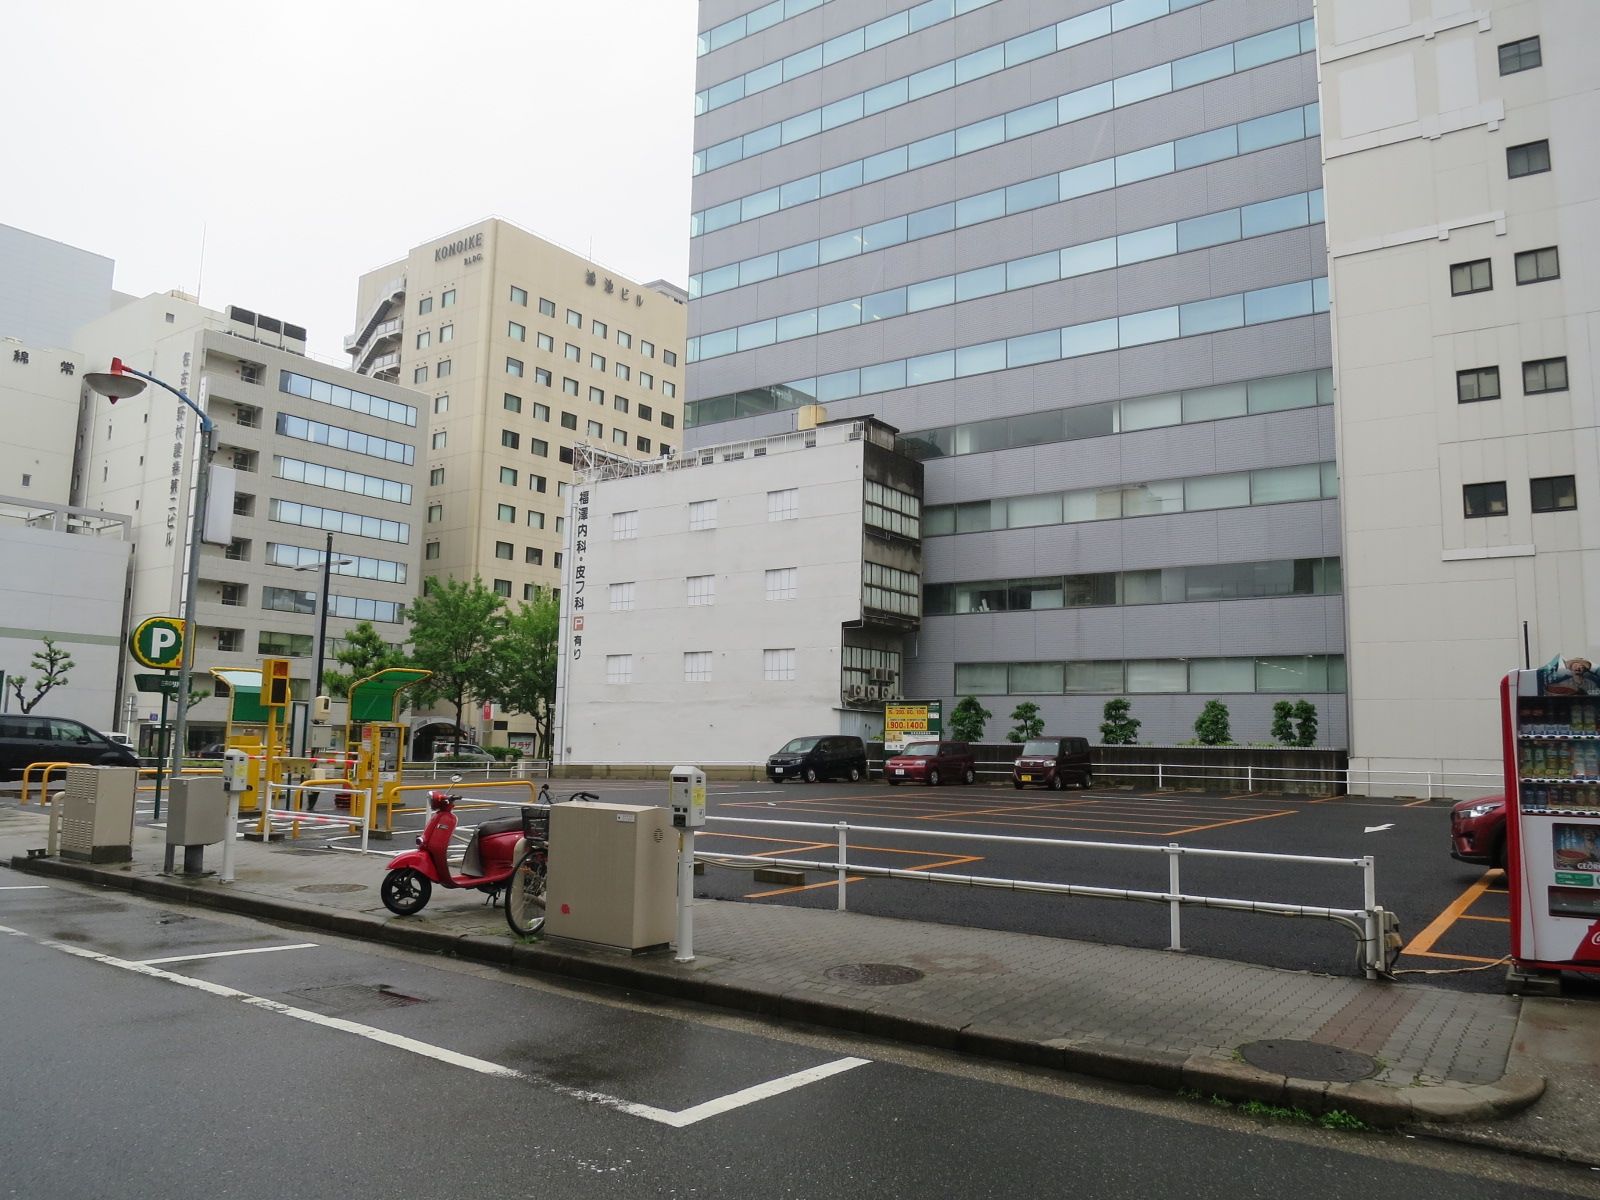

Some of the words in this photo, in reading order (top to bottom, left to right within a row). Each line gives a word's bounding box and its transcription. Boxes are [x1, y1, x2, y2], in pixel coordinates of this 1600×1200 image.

[435, 232, 483, 262] KONOIKE
[150, 627, 176, 659] P
[573, 635, 583, 661] 有り
